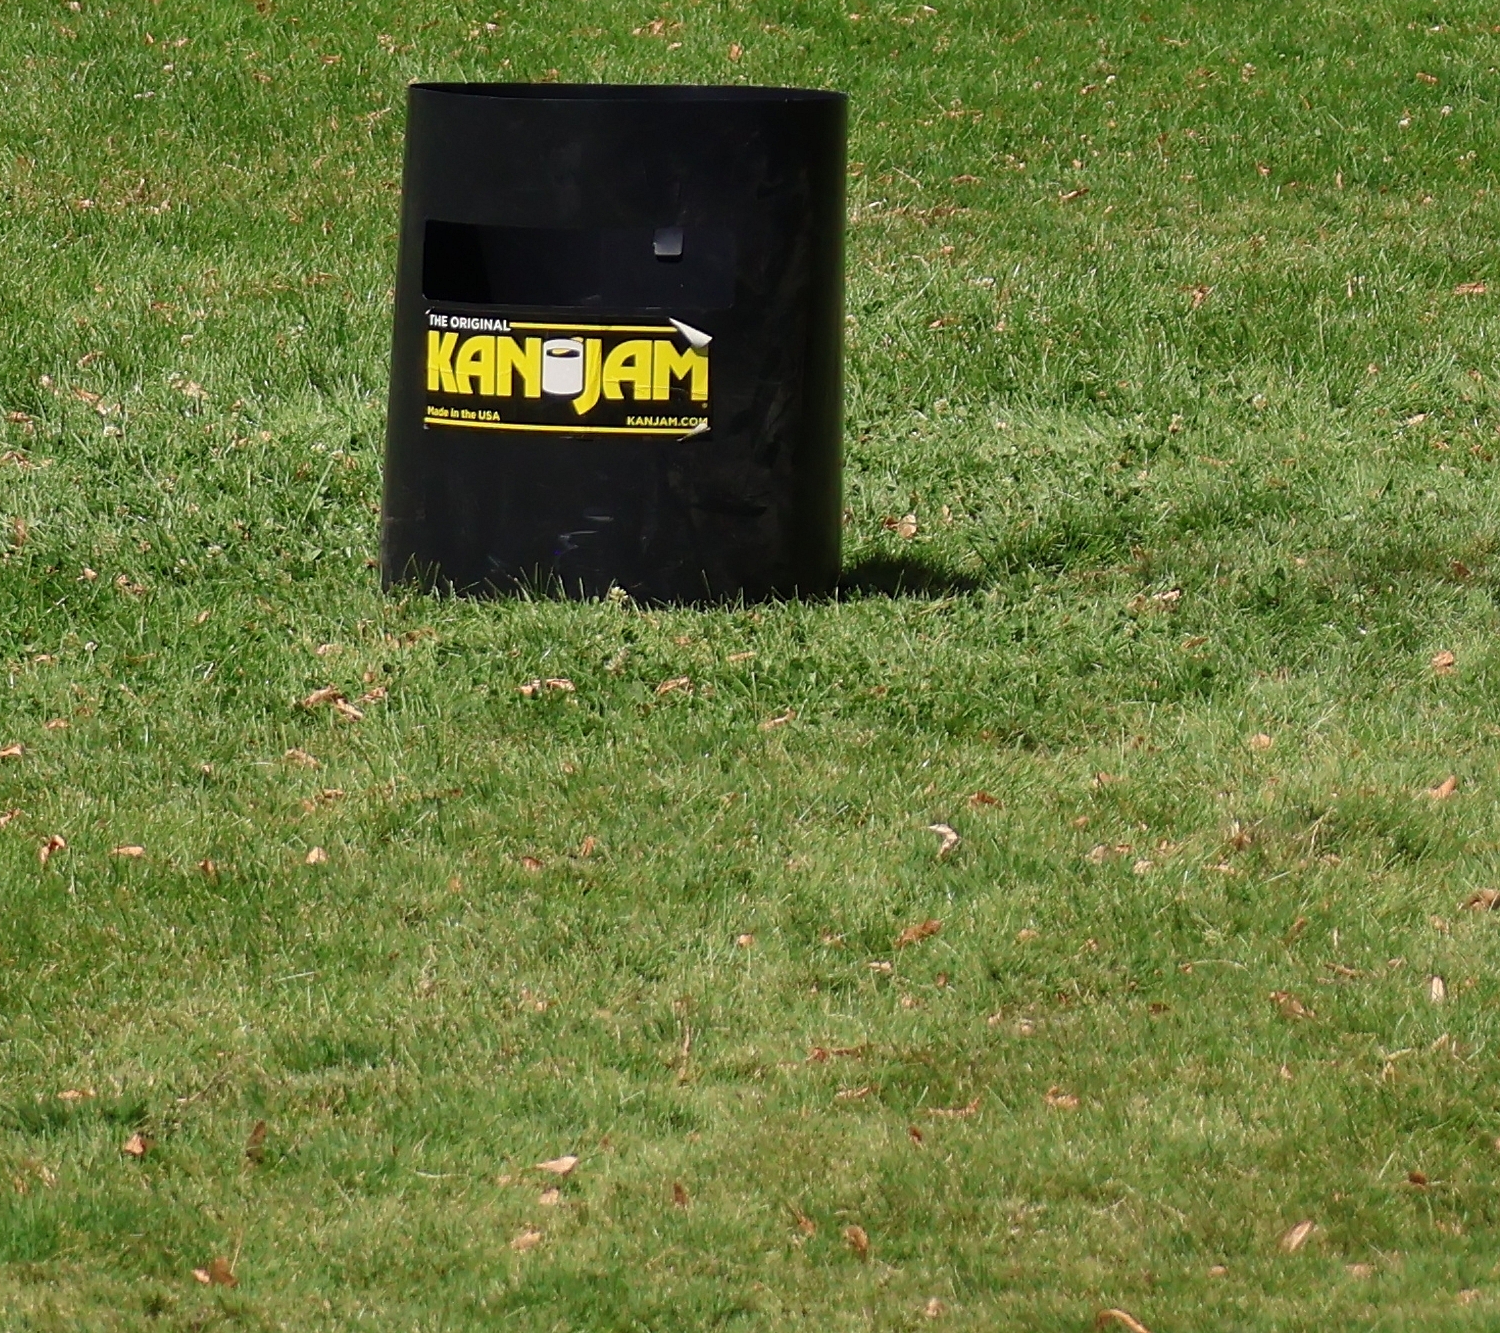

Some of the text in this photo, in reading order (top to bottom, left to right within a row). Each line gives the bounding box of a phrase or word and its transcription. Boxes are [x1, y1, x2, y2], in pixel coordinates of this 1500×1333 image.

[429, 314, 511, 331] THE ORIGINAL
[427, 405, 500, 421] Made in the USA
[626, 416, 708, 427] KANJAM.COM
